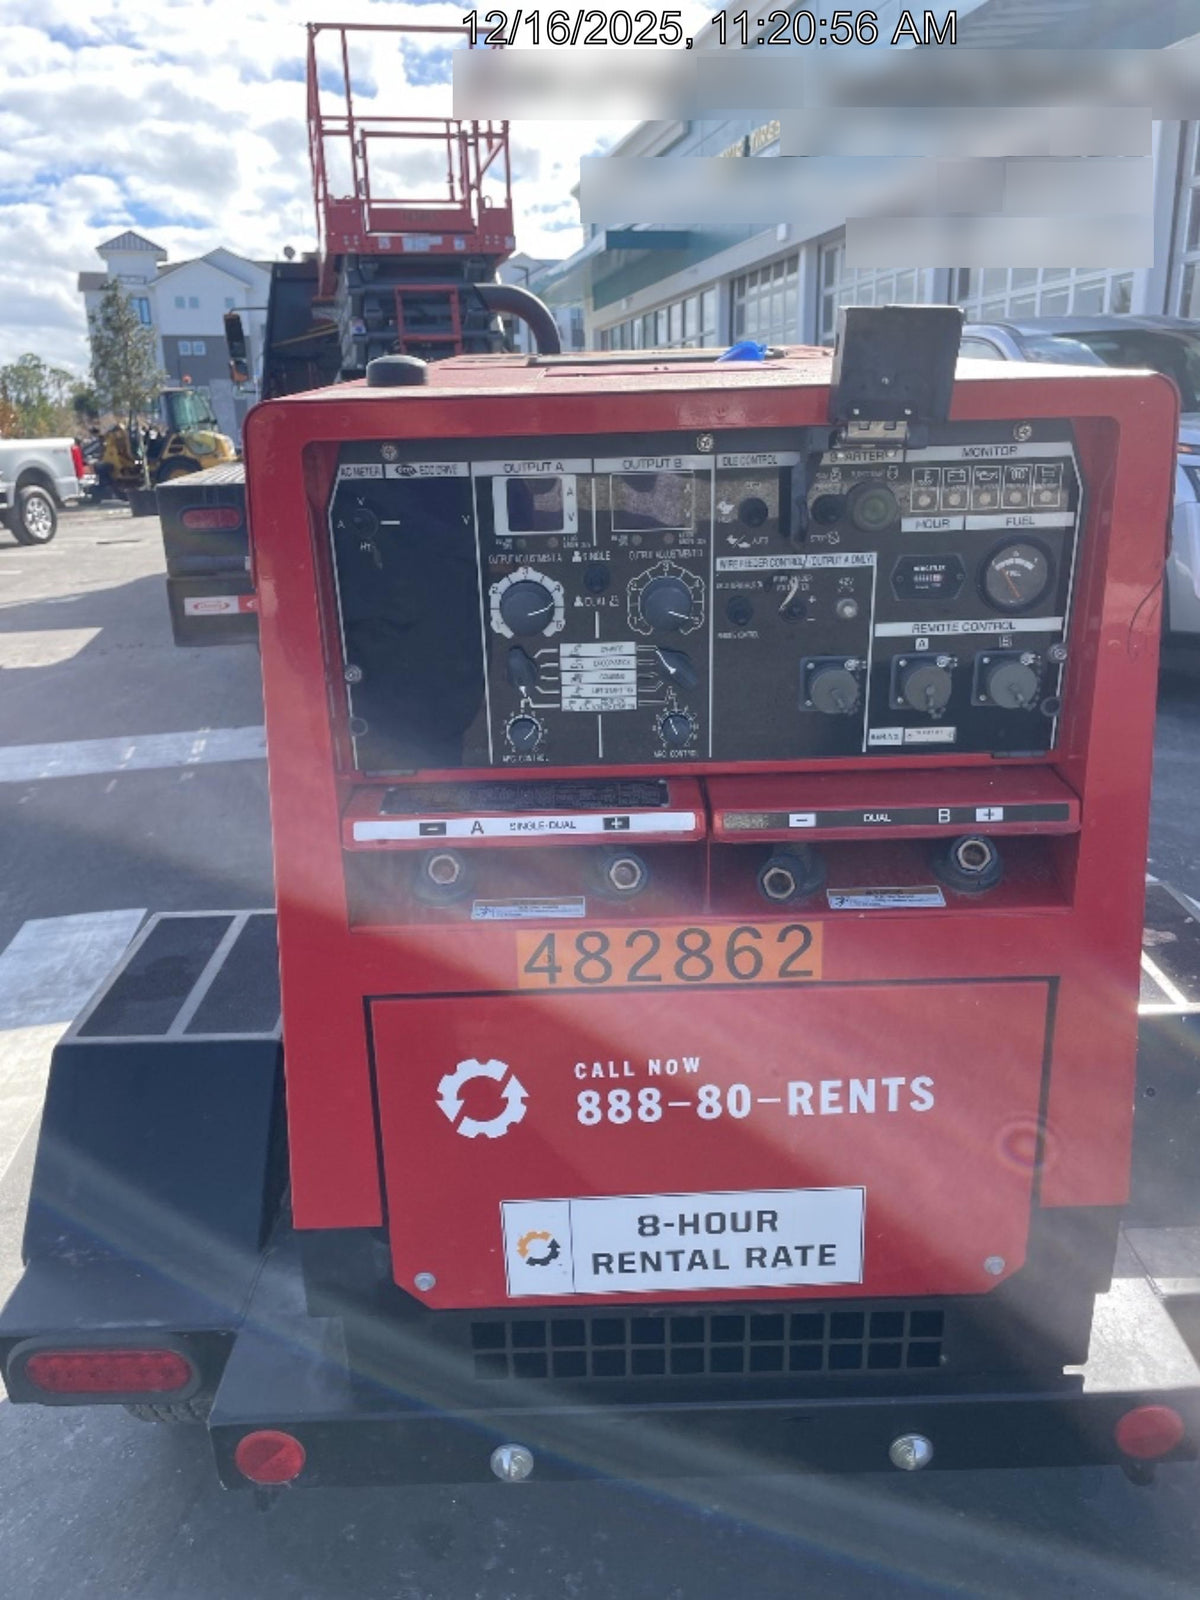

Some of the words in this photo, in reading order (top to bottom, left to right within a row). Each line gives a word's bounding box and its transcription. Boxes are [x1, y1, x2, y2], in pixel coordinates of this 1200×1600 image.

[829, 451, 885, 463] SARTER
[961, 446, 1018, 457] MONITOR
[503, 463, 552, 473] OUTPUT
[554, 462, 564, 472] A
[621, 459, 672, 469] OUTPUT
[673, 459, 682, 468] B
[915, 519, 951, 529] HOUR
[1006, 515, 1035, 526] FUEL
[912, 623, 959, 634] REMOTE
[961, 622, 1016, 632] CONTROL
[864, 813, 891, 822] DUAL
[938, 809, 951, 822] B
[471, 821, 485, 835] A
[523, 924, 814, 985] 482862
[574, 1060, 635, 1079] CALL
[648, 1057, 700, 1076] NOW
[577, 1075, 935, 1126] 888-80-RENTS
[637, 1210, 778, 1237] 8-HOUR
[592, 1249, 729, 1275] RENTAL
[746, 1244, 837, 1269] RATE
